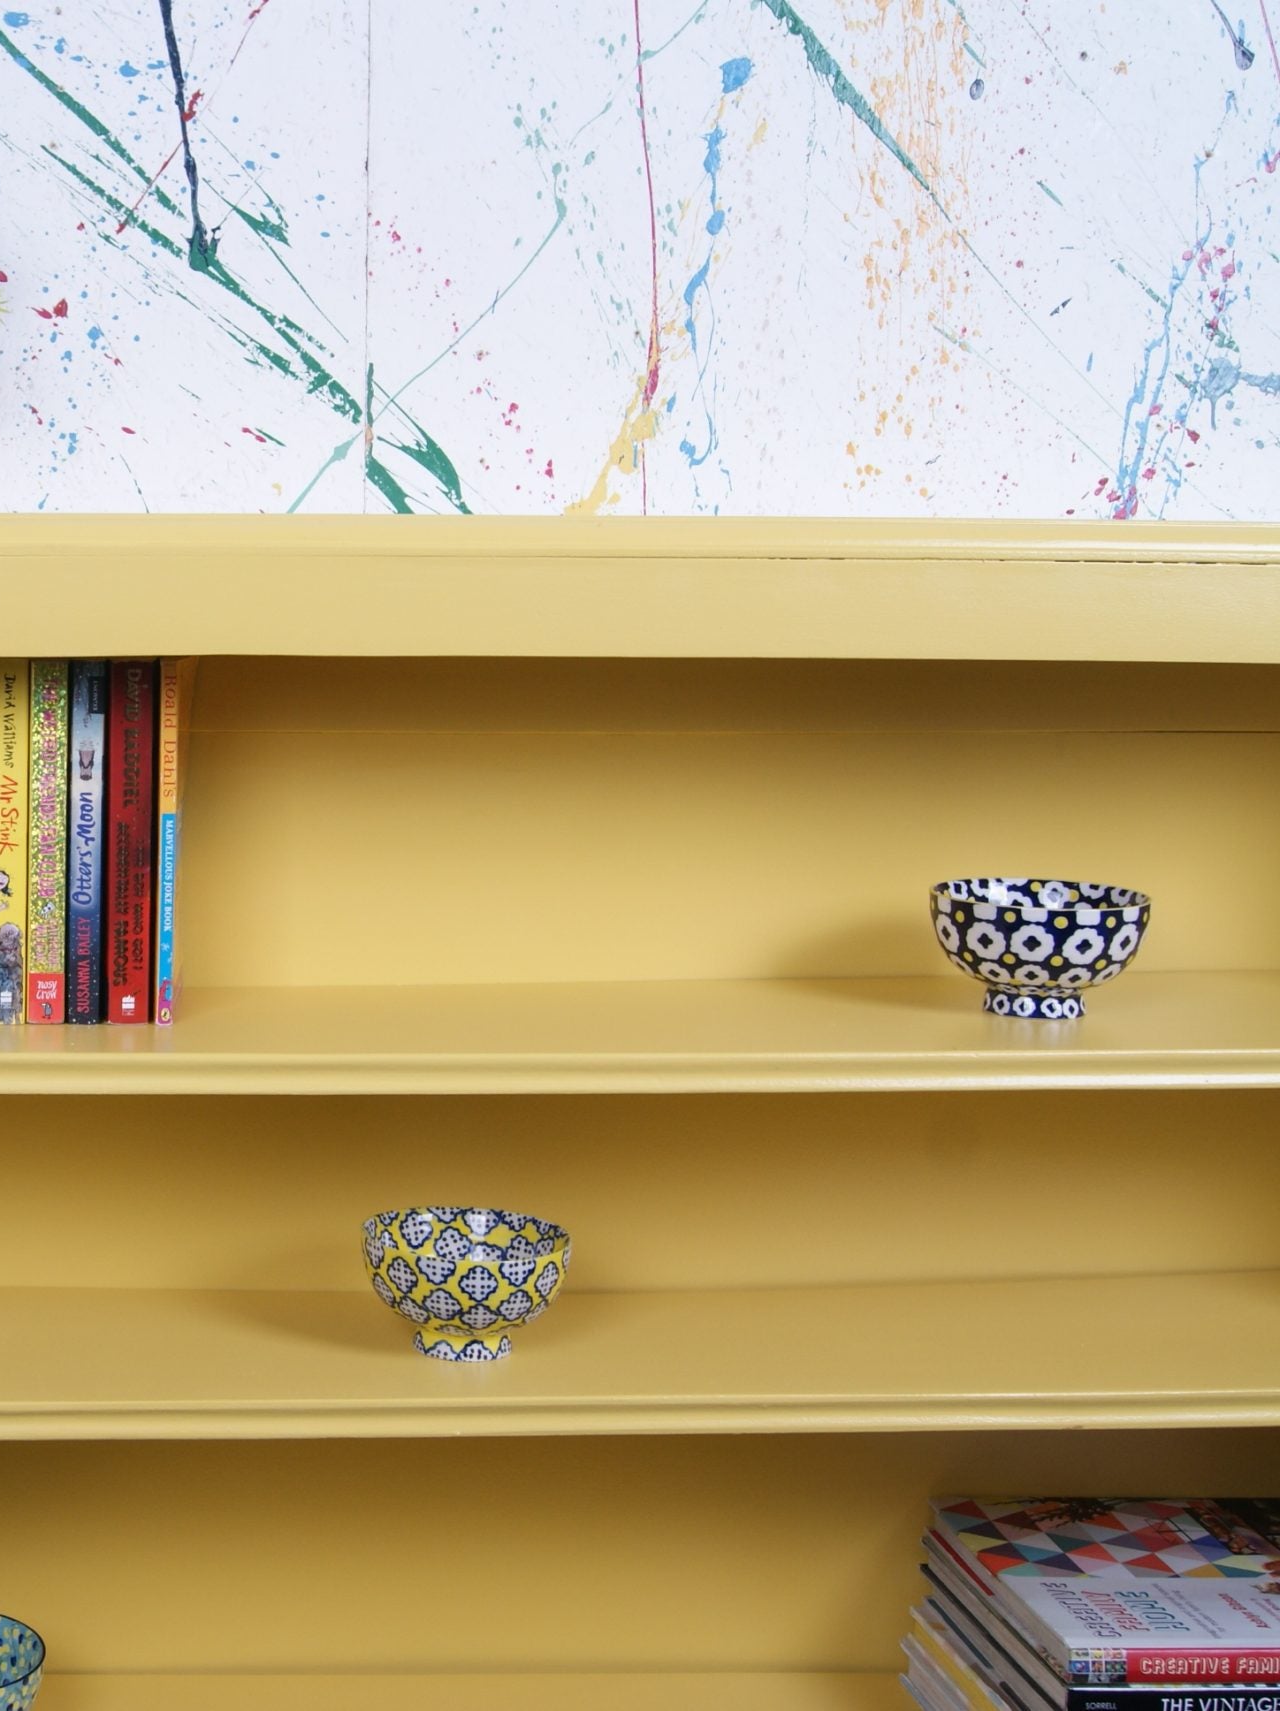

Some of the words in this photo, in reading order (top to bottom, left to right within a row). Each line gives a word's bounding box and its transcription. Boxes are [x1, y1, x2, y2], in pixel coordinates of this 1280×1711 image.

[3, 674, 16, 708] David
[126, 669, 142, 720] DAVID
[163, 676, 176, 727] Roald
[3, 714, 16, 767] Walliams
[0, 775, 18, 803] Mr
[123, 728, 140, 807] BADDIEL
[163, 740, 176, 797] Dahl's
[0, 807, 18, 855] Stink
[76, 792, 95, 846] Moon
[115, 822, 129, 915] ACCIDENTALLY
[164, 819, 174, 880] MARVELLOUS
[163, 882, 172, 904] JOKE
[77, 917, 90, 955] BAILEY
[163, 907, 171, 931] BOOK
[113, 920, 128, 986] FAMOUS
[76, 960, 90, 1012] SUSANNA
[1040, 1582, 1122, 1638] CREATIVE
[1081, 1589, 1149, 1631] FAMILY
[1114, 1590, 1190, 1631] HOME
[1140, 1657, 1229, 1674] CREATIVE
[1085, 1702, 1116, 1710] SORRELL
[1162, 1697, 1193, 1711] THE
